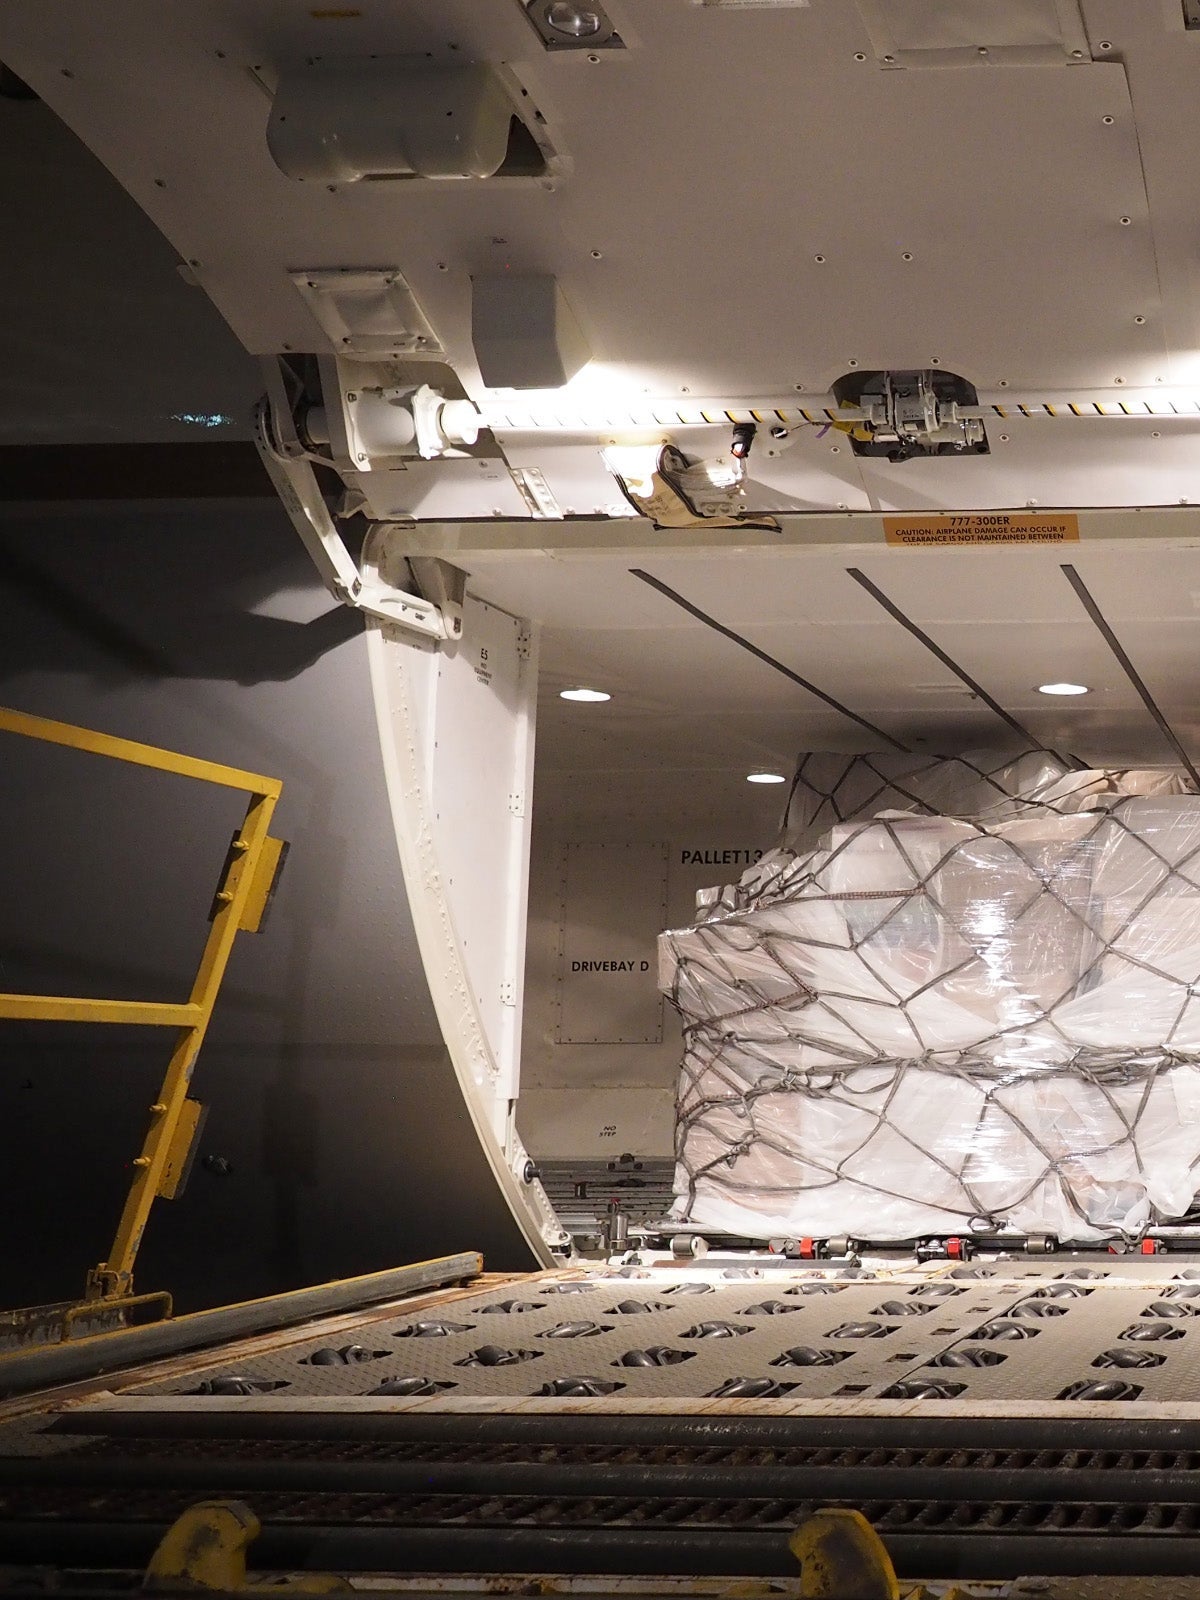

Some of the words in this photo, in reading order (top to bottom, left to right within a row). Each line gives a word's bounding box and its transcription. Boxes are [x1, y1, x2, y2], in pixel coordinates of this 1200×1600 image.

[950, 516, 1010, 526] 777-300ER
[895, 528, 934, 536] CAUTION:
[936, 527, 973, 535] AIRPLANE
[974, 526, 1008, 535] DAMAGE
[1029, 525, 1058, 533] OCCUR
[902, 535, 947, 543] CLEARANCE
[977, 533, 1026, 541] MAINTAINED
[1028, 532, 1065, 540] BETWEEN
[572, 961, 635, 972] DRIVEBAY
[640, 961, 649, 972] D
